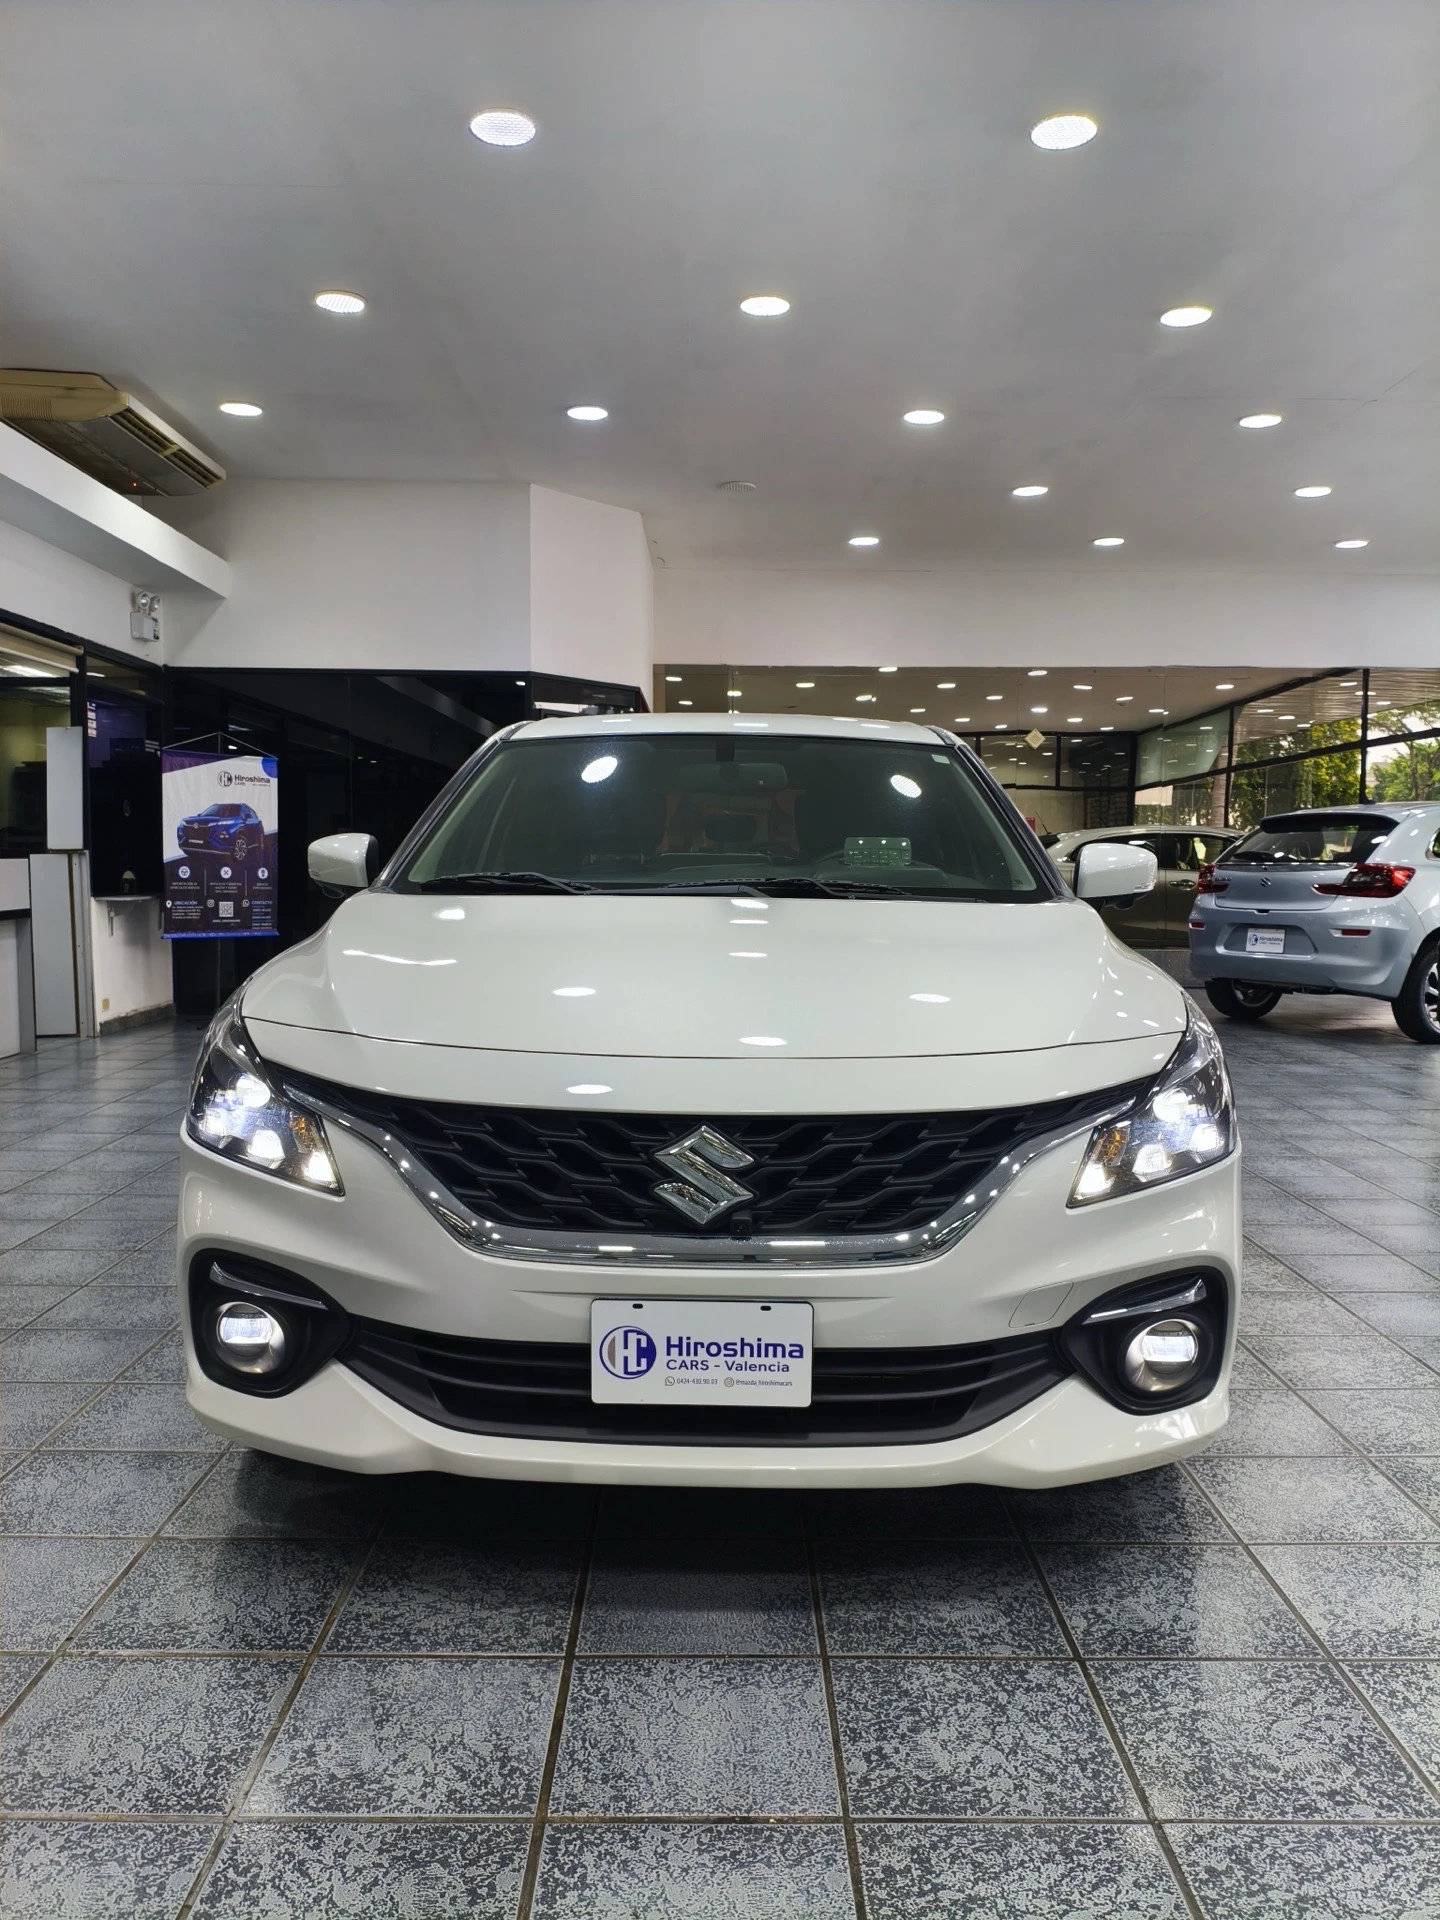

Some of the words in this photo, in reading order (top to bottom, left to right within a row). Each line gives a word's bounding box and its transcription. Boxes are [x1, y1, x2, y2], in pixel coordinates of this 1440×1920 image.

[234, 773, 271, 783] Hiroshima
[665, 1336, 804, 1359] Hiroshima
[666, 1359, 710, 1371] CARS
[725, 1360, 790, 1373] Valencia
